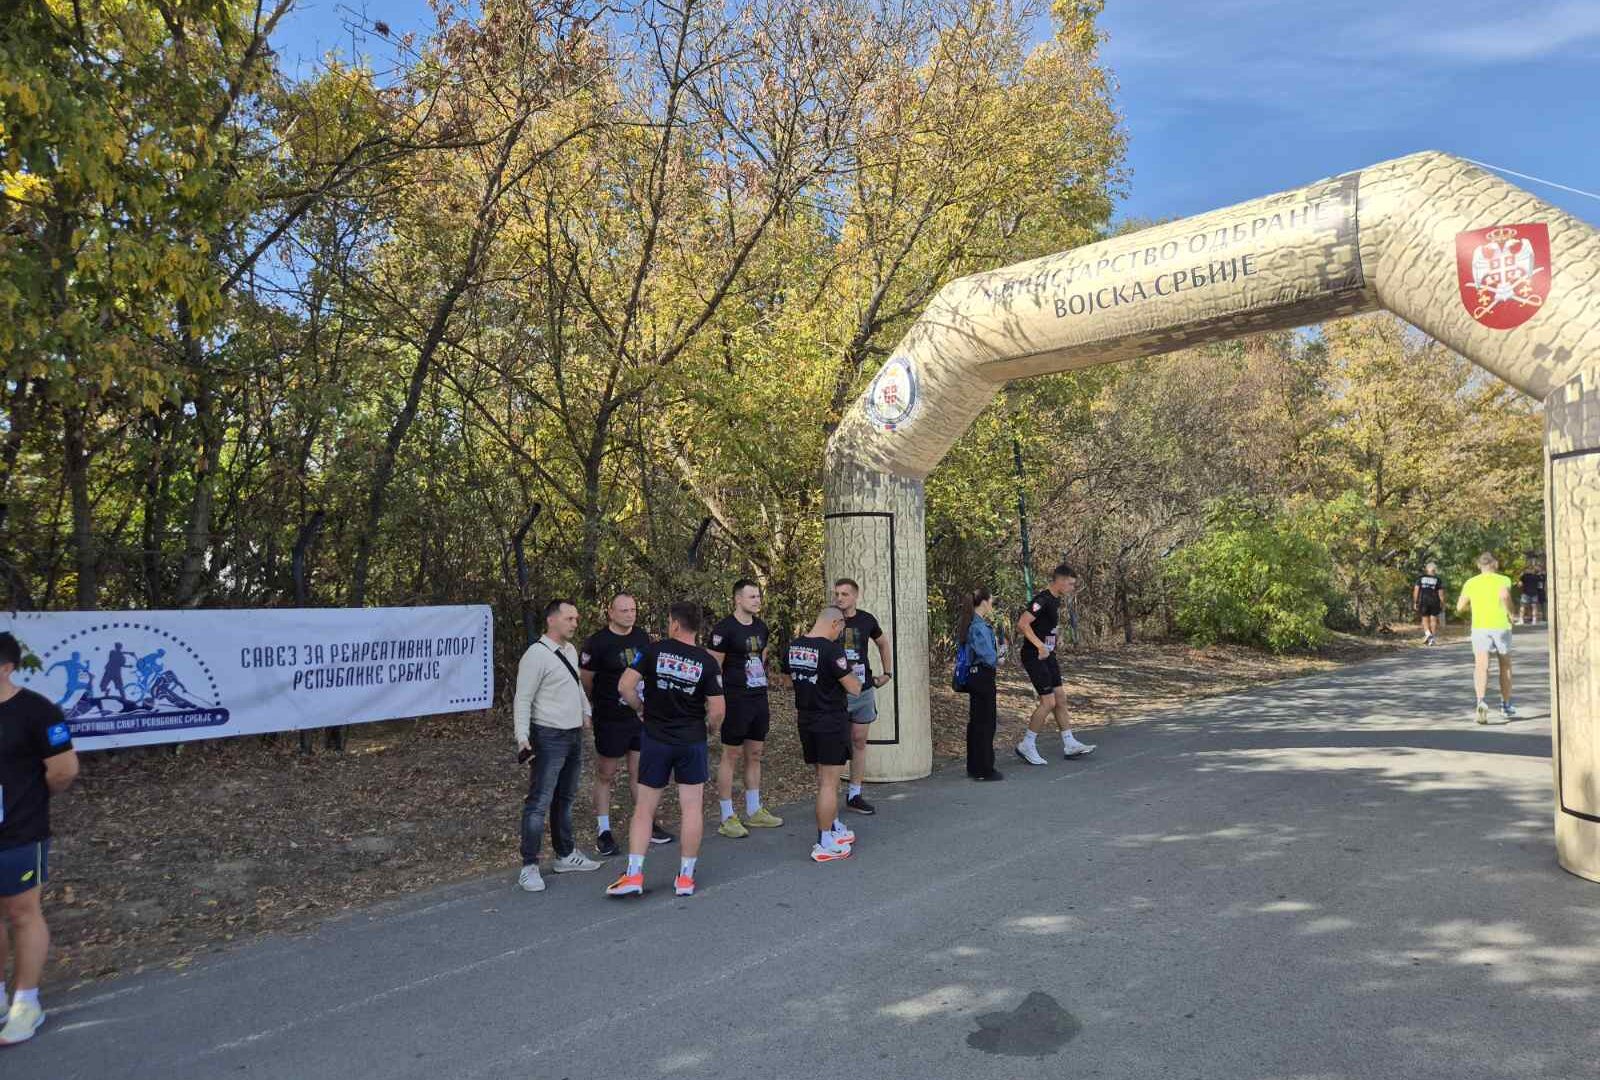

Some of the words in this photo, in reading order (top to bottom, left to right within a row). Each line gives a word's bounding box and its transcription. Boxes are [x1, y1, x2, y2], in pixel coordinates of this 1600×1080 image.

[1188, 200, 1330, 254] ОДБРАНЕ
[1054, 281, 1147, 318] ВОЈСКА
[1154, 253, 1258, 296] СРБИЈЕ
[241, 645, 297, 669] САВЕЗ
[303, 644, 324, 665] ЗА
[330, 639, 432, 664] РЕКРЕАТИВНИ
[436, 636, 476, 657] СПОРТ
[293, 664, 384, 691] РЕПУБЛИКЕ
[389, 661, 440, 684] СРБИЈЕ
